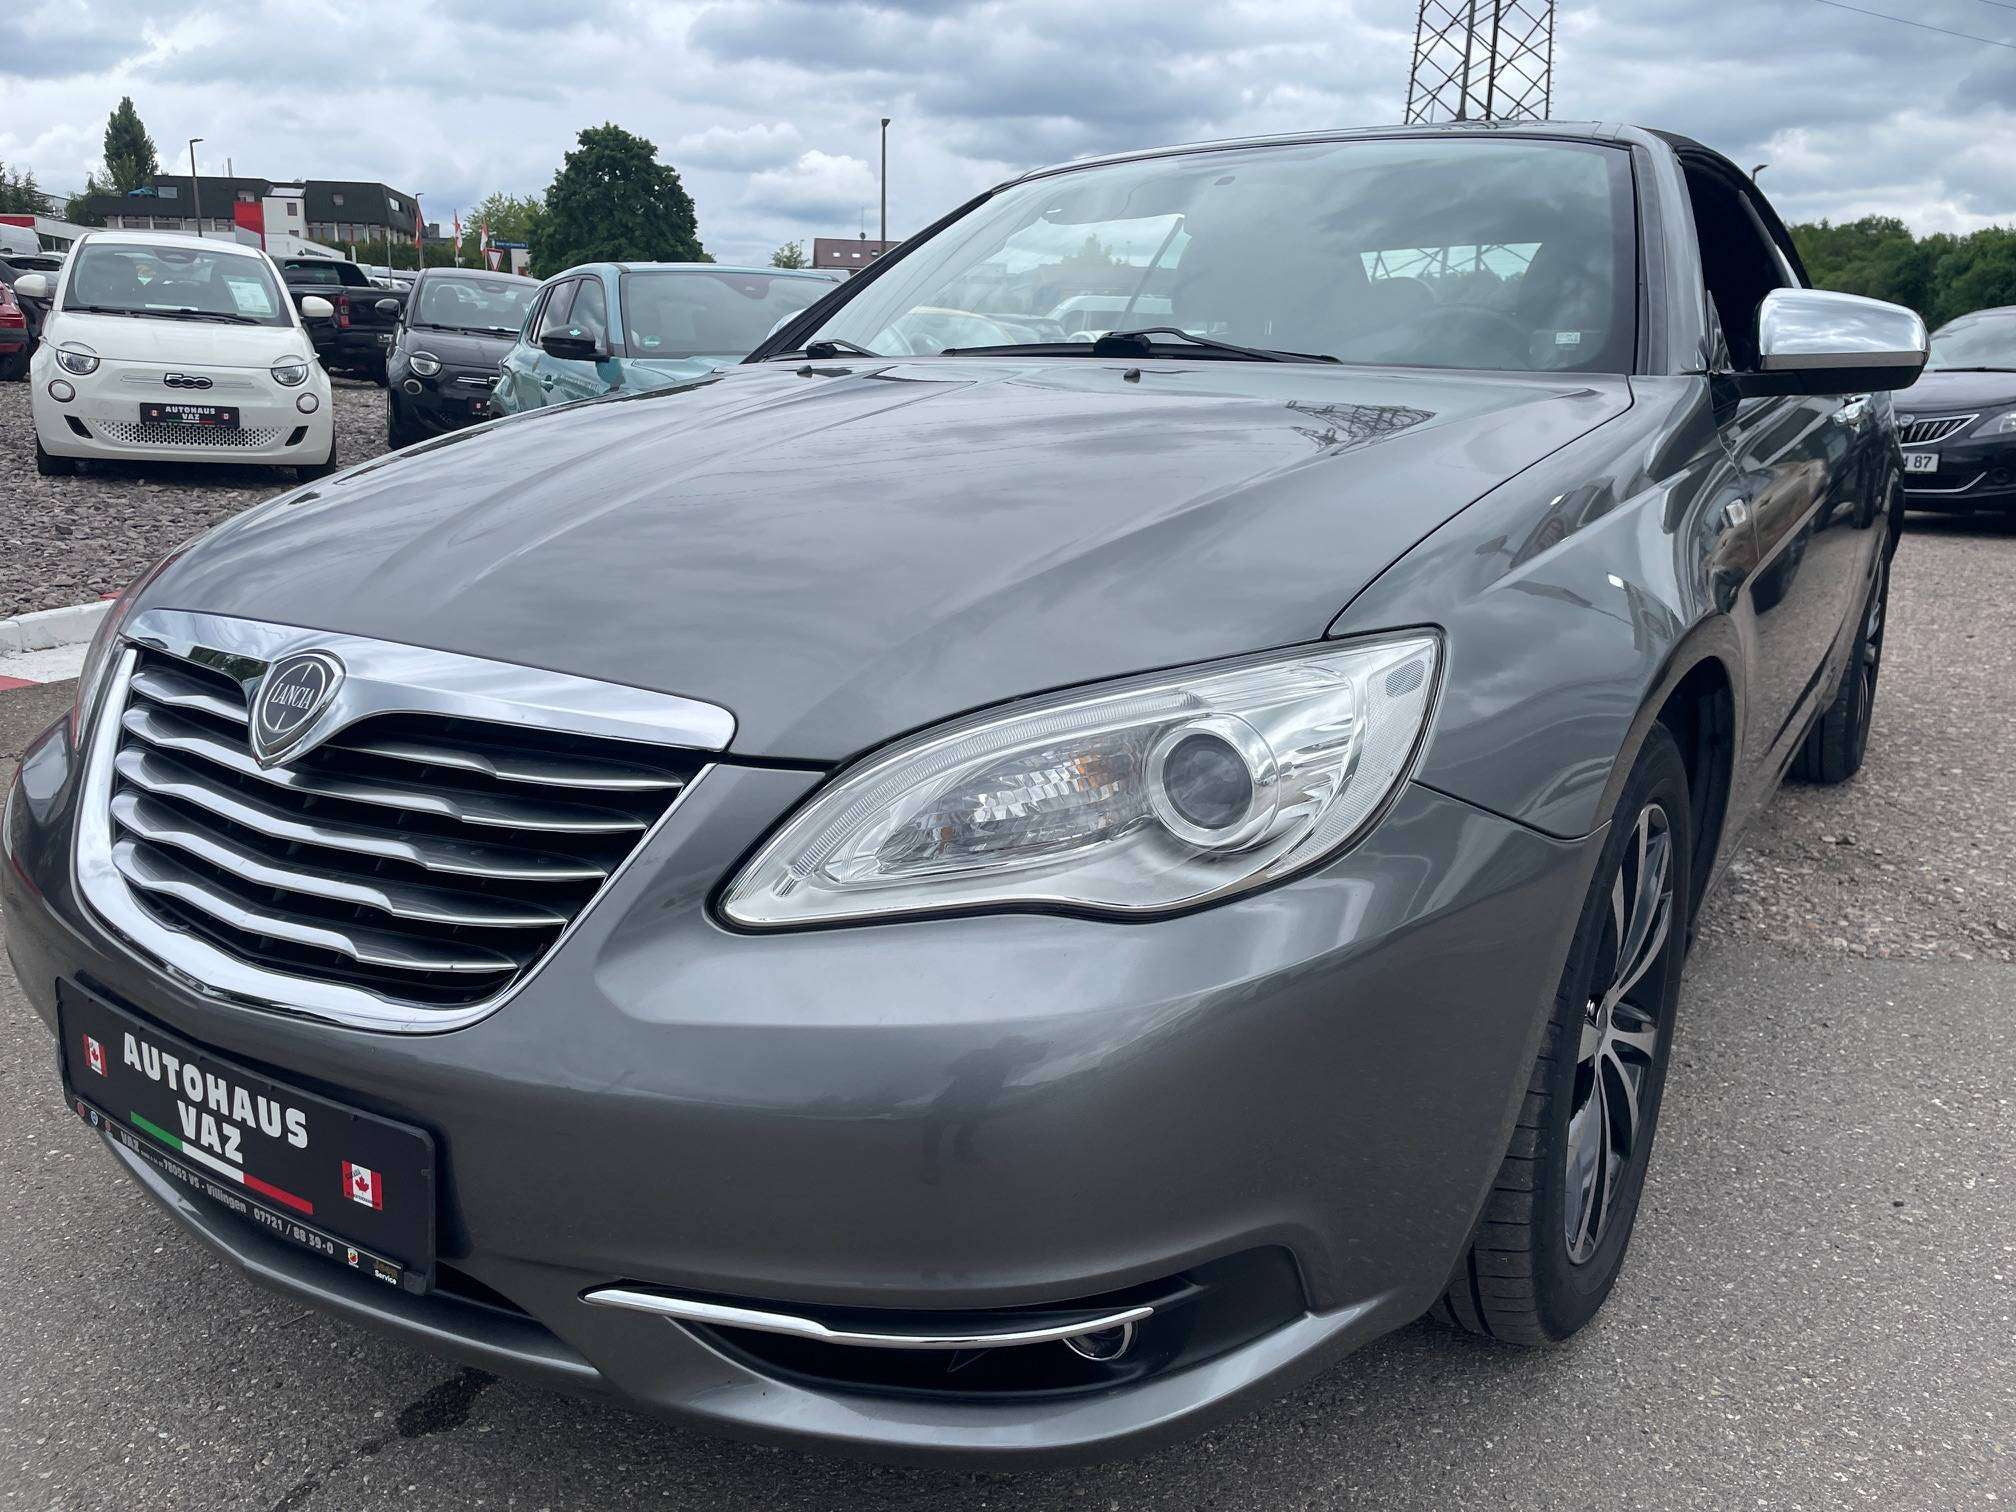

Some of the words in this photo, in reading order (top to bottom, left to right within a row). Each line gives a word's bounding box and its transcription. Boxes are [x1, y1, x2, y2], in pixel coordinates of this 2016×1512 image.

[164, 372, 213, 389] 500
[165, 406, 215, 415] AUTOHAUS
[1914, 455, 1932, 469] 87
[270, 683, 315, 710] LANCIA
[123, 1031, 309, 1149] AUTOHAUS
[177, 1100, 244, 1164] VAZ
[120, 1131, 139, 1152] VAZ
[207, 1183, 247, 1214] Villingen
[253, 1207, 282, 1232] 07721
[373, 1269, 398, 1286] Service
